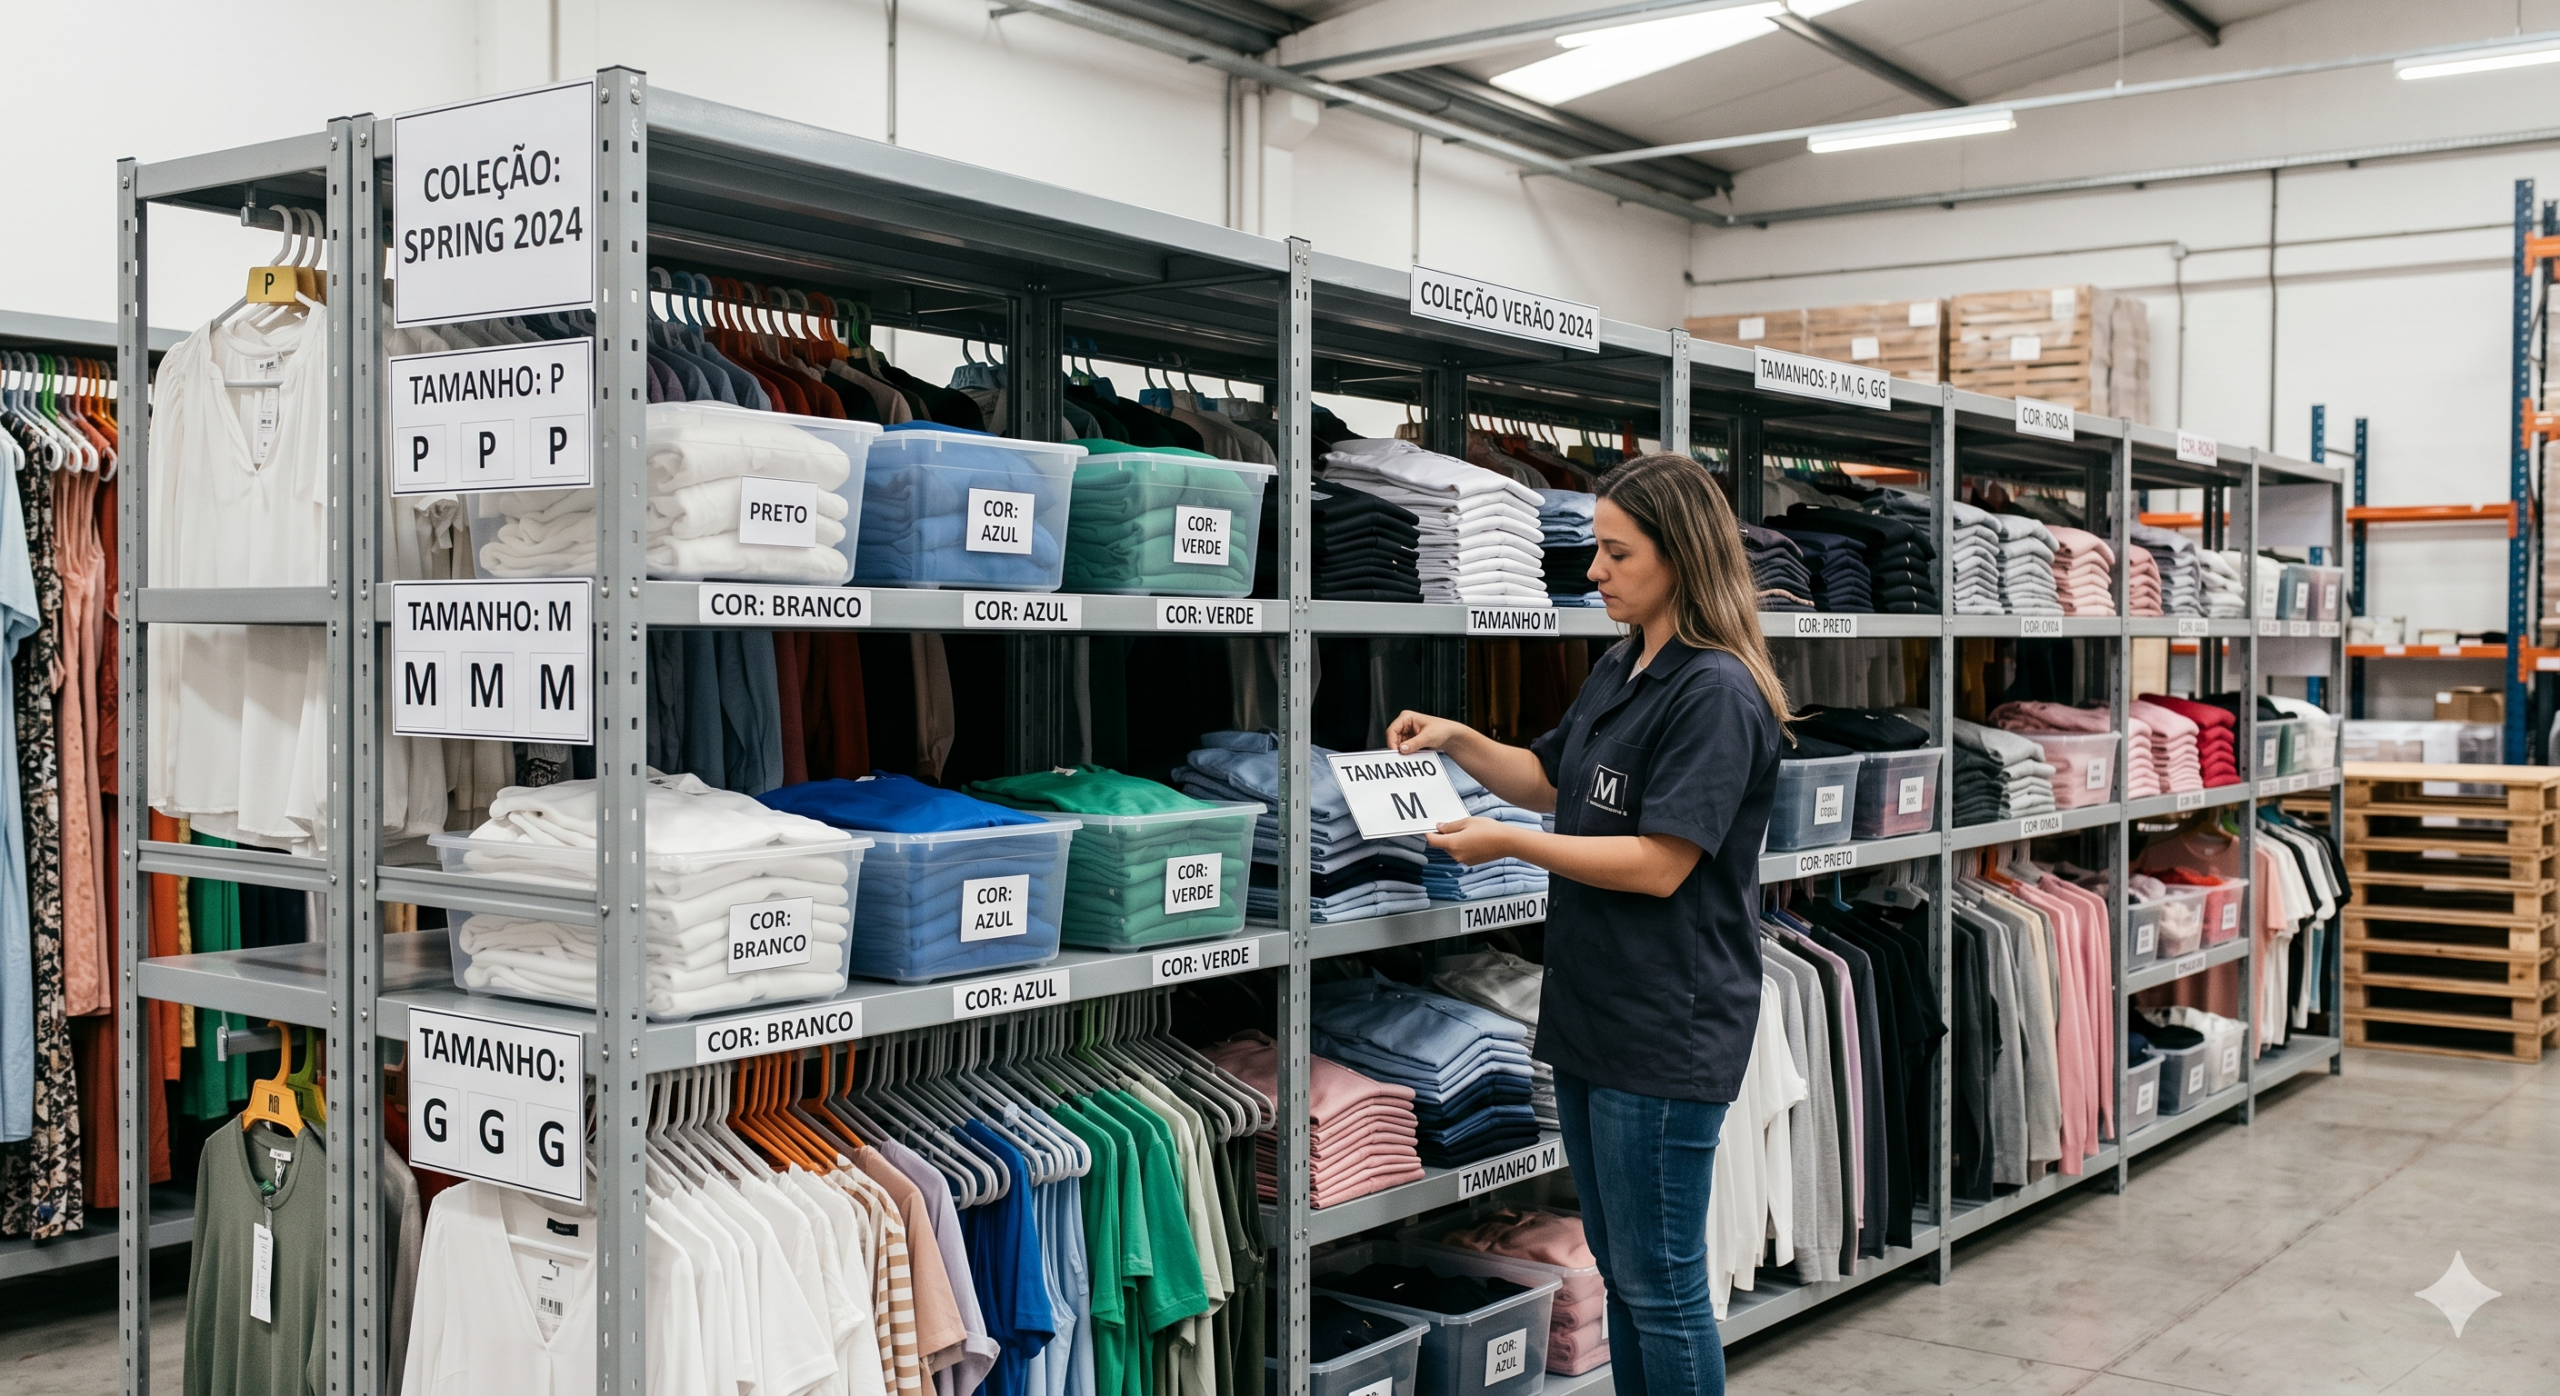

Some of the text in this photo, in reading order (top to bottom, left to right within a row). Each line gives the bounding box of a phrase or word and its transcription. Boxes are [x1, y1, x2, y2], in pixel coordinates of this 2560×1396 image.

[424, 144, 561, 202] COLEÇÃO:
[404, 206, 584, 264] SPRING 2024
[264, 273, 275, 295] P
[1421, 281, 1593, 340] COLEÇÃO VERÃO 2024
[409, 362, 564, 405] TAMANHO: P
[1761, 359, 1886, 400] TAMANHOS: P, M, G, GG
[2023, 407, 2069, 432] COR: ROSA
[412, 426, 567, 472] P P P
[749, 502, 808, 524] PRETO
[983, 500, 1019, 518] COR:
[981, 523, 1019, 544] AZUL
[1187, 515, 1218, 532] COR:
[1182, 538, 1222, 556] VERDE
[408, 601, 571, 632] TAMANHO: M
[711, 594, 862, 619] COR: BRANCO
[974, 600, 1069, 622] COR: AZUL
[1165, 605, 1255, 625] COR: VERDE
[1471, 610, 1556, 630] TAMANHO M
[1799, 618, 1852, 634] COR: PRETO
[405, 662, 575, 711] M M M
[1341, 760, 1436, 782] TAMANHO
[1593, 772, 1618, 805] M
[1390, 792, 1428, 821] M
[1177, 864, 1208, 880] COR:
[1801, 856, 1821, 871] COR:
[976, 886, 1012, 905] COR:
[1172, 884, 1214, 904] VERDE
[750, 911, 791, 931] COR:
[974, 909, 1014, 930] AZUL
[1465, 900, 1536, 928] TAMANHO
[733, 934, 806, 960] BRANCO
[1161, 947, 1250, 978] COR: VERDE
[964, 978, 1058, 1010] COR: AZUL
[707, 1011, 854, 1053] COR: BRANCO
[419, 1027, 566, 1084] TAMANHO:
[423, 1098, 565, 1168] G G G
[1463, 1148, 1556, 1194] TAMANHO M
[1496, 1340, 1517, 1356] COR:
[1495, 1356, 1517, 1374] AZUL
